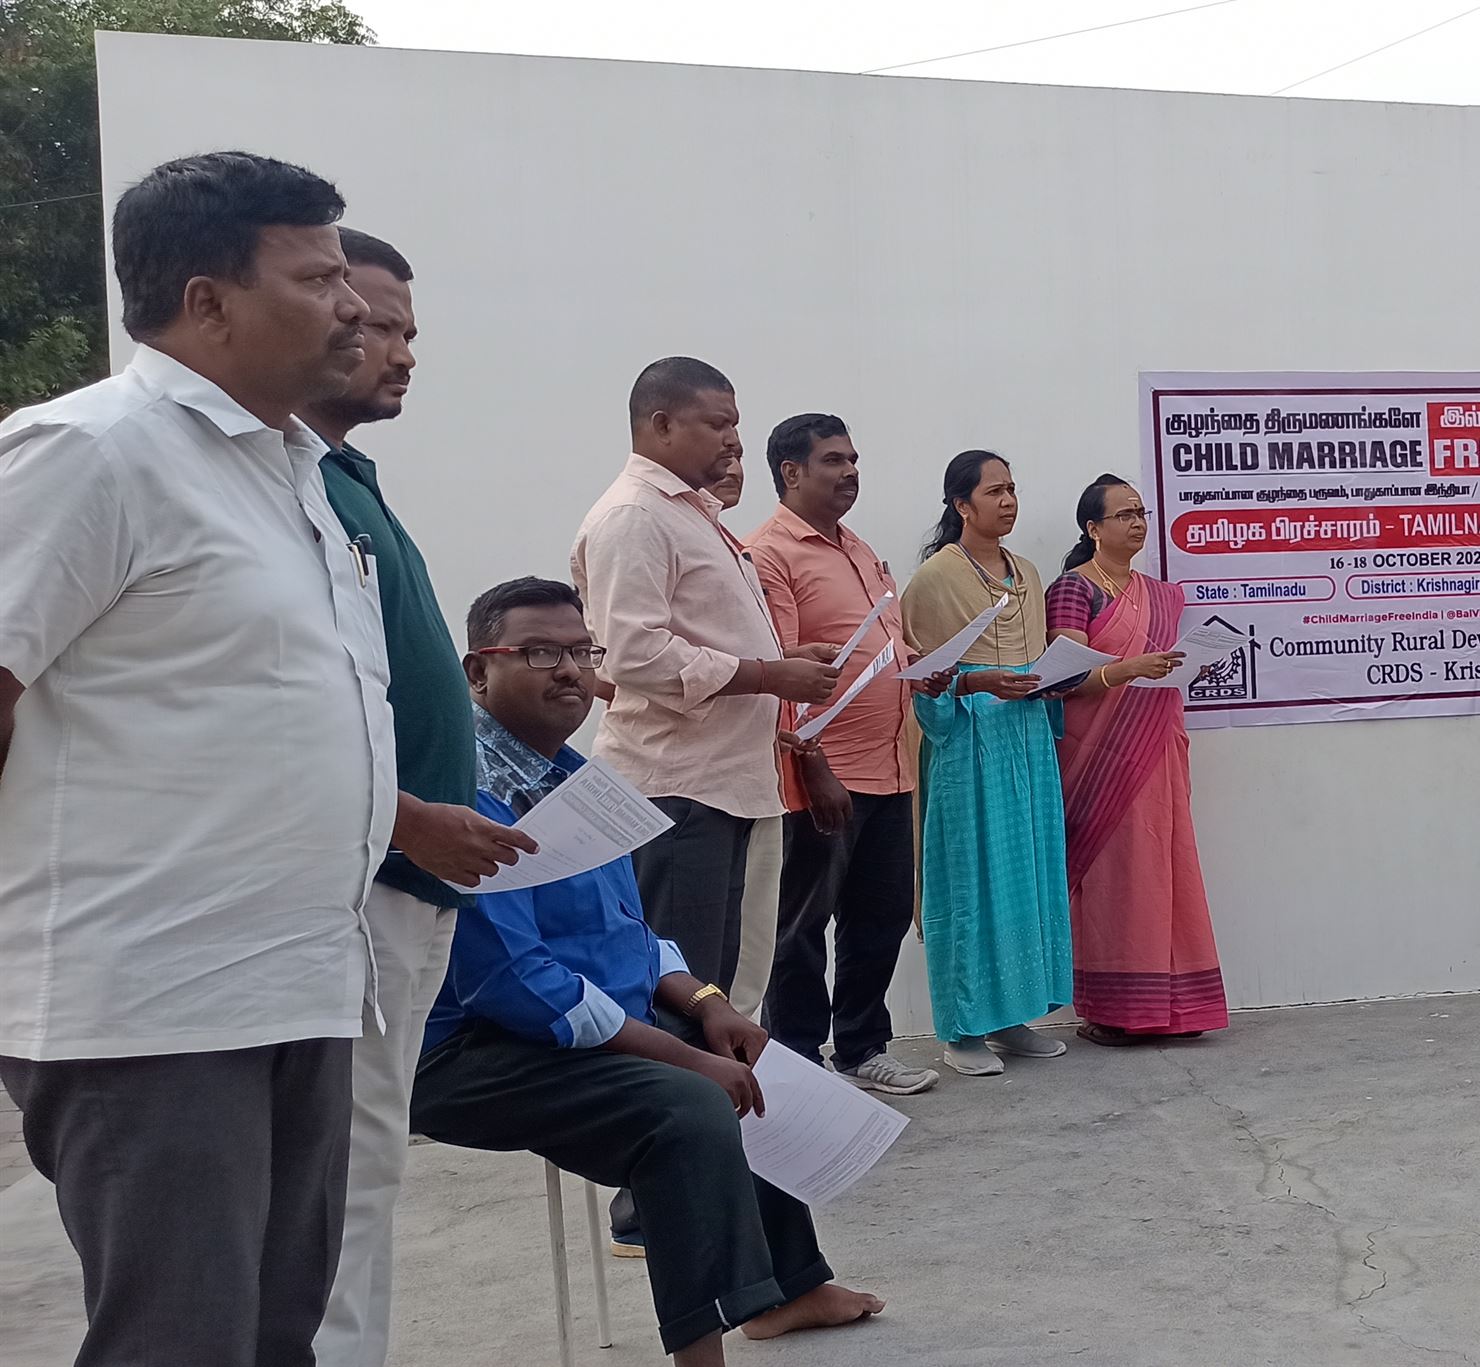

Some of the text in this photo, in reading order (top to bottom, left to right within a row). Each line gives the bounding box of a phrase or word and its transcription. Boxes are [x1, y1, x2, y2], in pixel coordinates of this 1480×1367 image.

[1165, 407, 1260, 438] குழந்தை
[1172, 442, 1260, 472] CHILD
[1268, 440, 1424, 469] MARRIAGE
[1186, 518, 1266, 549] தமிழக
[1271, 513, 1380, 543] பிரச்சாரம்
[1373, 553, 1452, 568] OCTOBER
[1196, 585, 1229, 600] State
[1241, 582, 1306, 598] Tamilnadu
[1361, 579, 1406, 594] District
[1303, 611, 1438, 624] #ChildMarriageFreeIndia
[1270, 634, 1385, 658] Community
[1391, 630, 1445, 652] Rural
[1367, 663, 1423, 684] CRDS
[1190, 687, 1246, 698] CRDS
